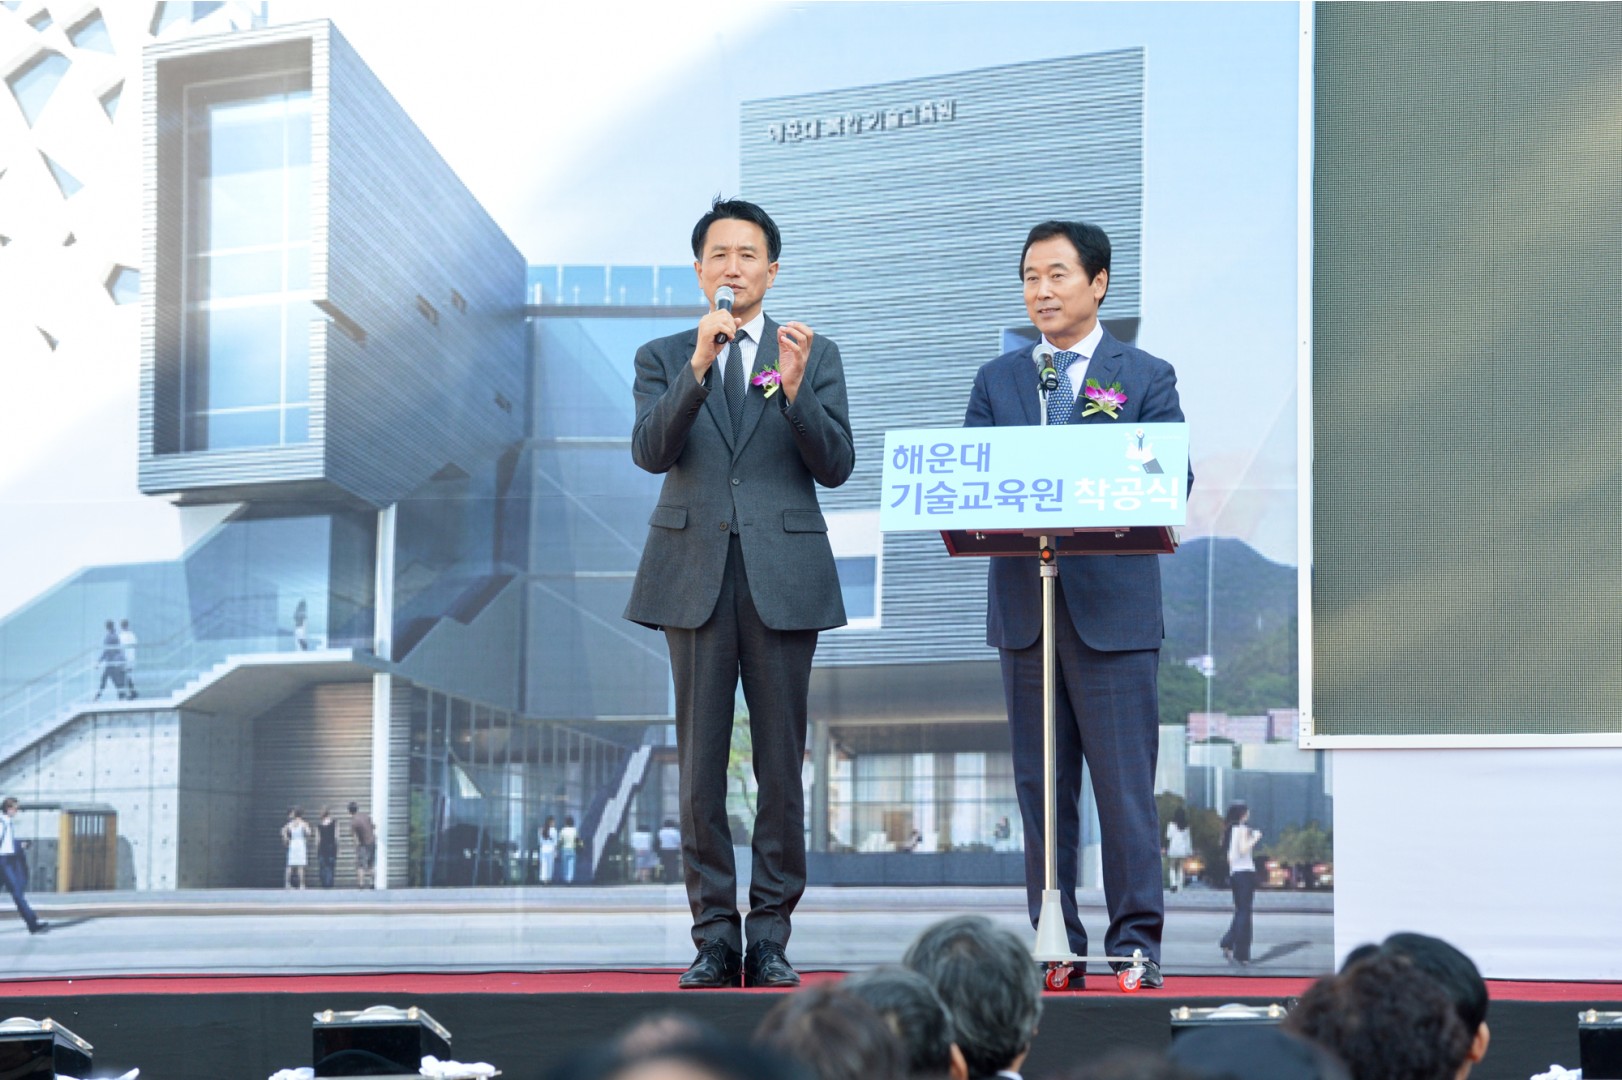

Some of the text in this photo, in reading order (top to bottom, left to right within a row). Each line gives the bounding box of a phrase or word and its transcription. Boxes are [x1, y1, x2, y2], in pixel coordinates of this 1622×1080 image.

[892, 442, 991, 475] 해운대
[890, 476, 1180, 516] 기술교육원 착공식
